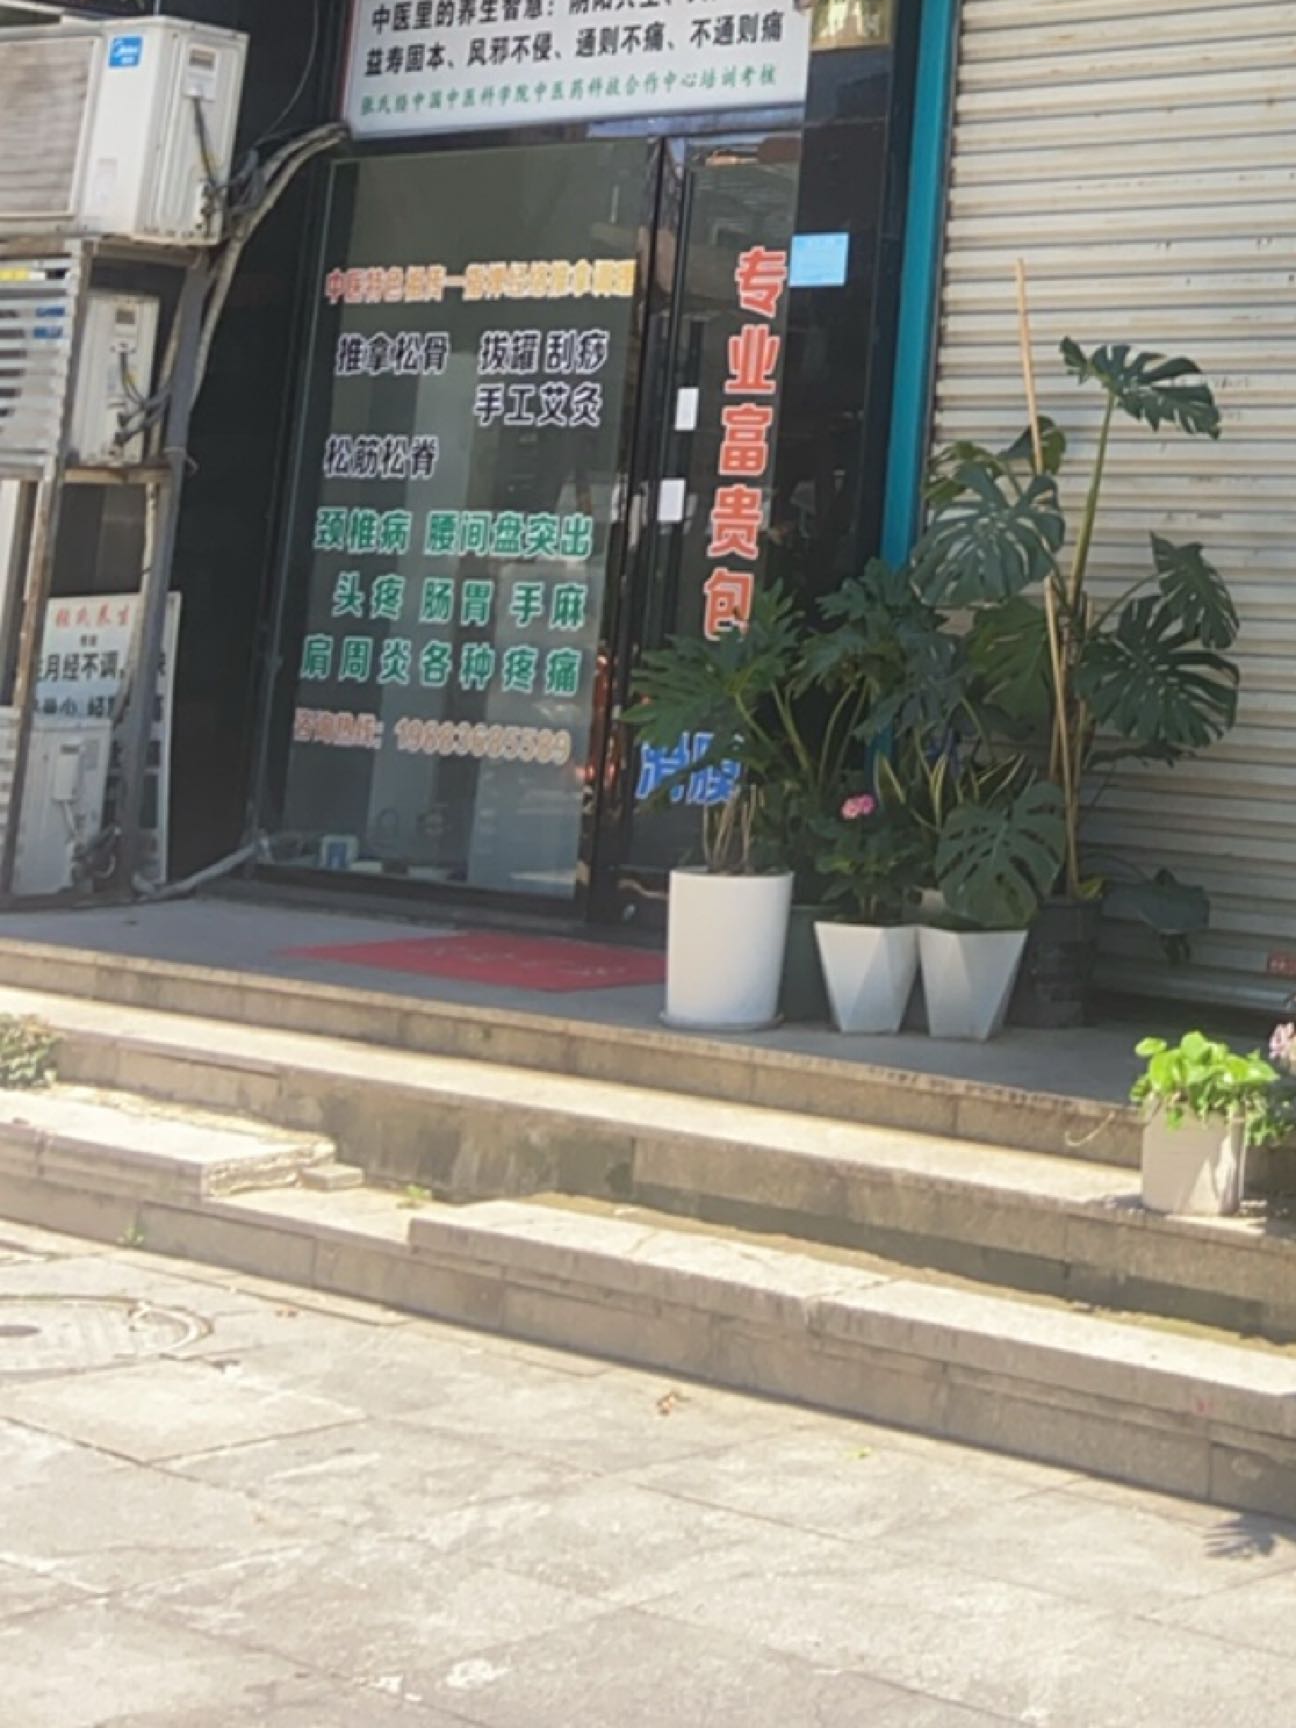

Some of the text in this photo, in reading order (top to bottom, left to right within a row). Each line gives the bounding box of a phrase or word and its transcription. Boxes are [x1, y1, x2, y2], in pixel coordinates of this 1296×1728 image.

[336, 329, 611, 376] 推拿松骨 拔罐 刮痧
[474, 382, 604, 427] 手工艾灸
[323, 435, 440, 481] 松筋松脊
[704, 245, 788, 642] 专业富贵包
[314, 506, 594, 561] 颈椎病 腰间盘突出
[330, 570, 588, 630] 头疼 肠胃 手麻
[298, 632, 584, 698] 肩周炎各种疼痛
